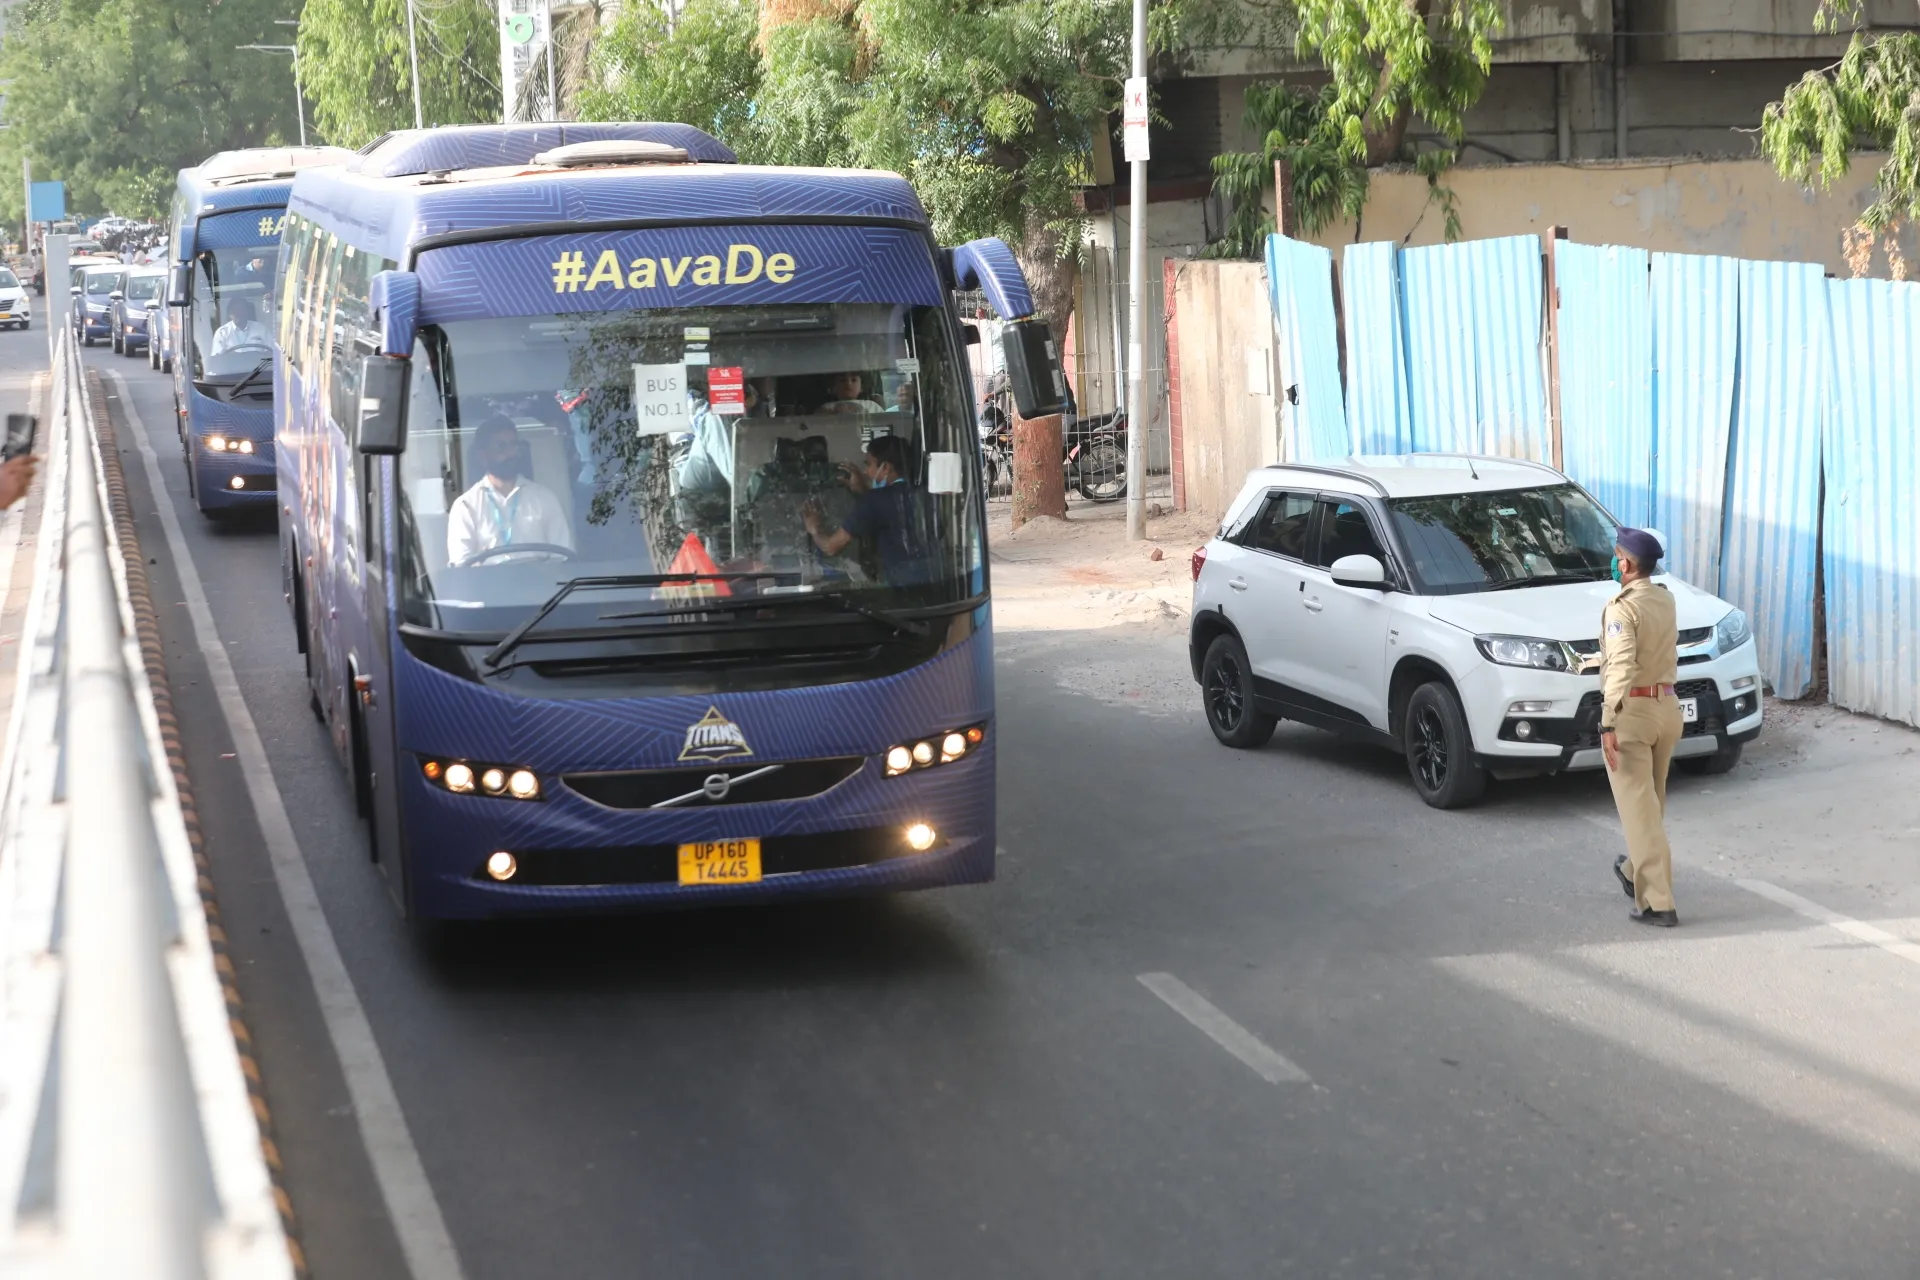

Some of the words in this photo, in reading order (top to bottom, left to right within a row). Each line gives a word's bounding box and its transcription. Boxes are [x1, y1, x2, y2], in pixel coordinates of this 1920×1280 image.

[551, 243, 796, 294] #AavaDe
[647, 377, 677, 392] BUS
[645, 402, 683, 416] NO.1
[684, 722, 746, 749] TITANS
[695, 860, 749, 880] T4445
